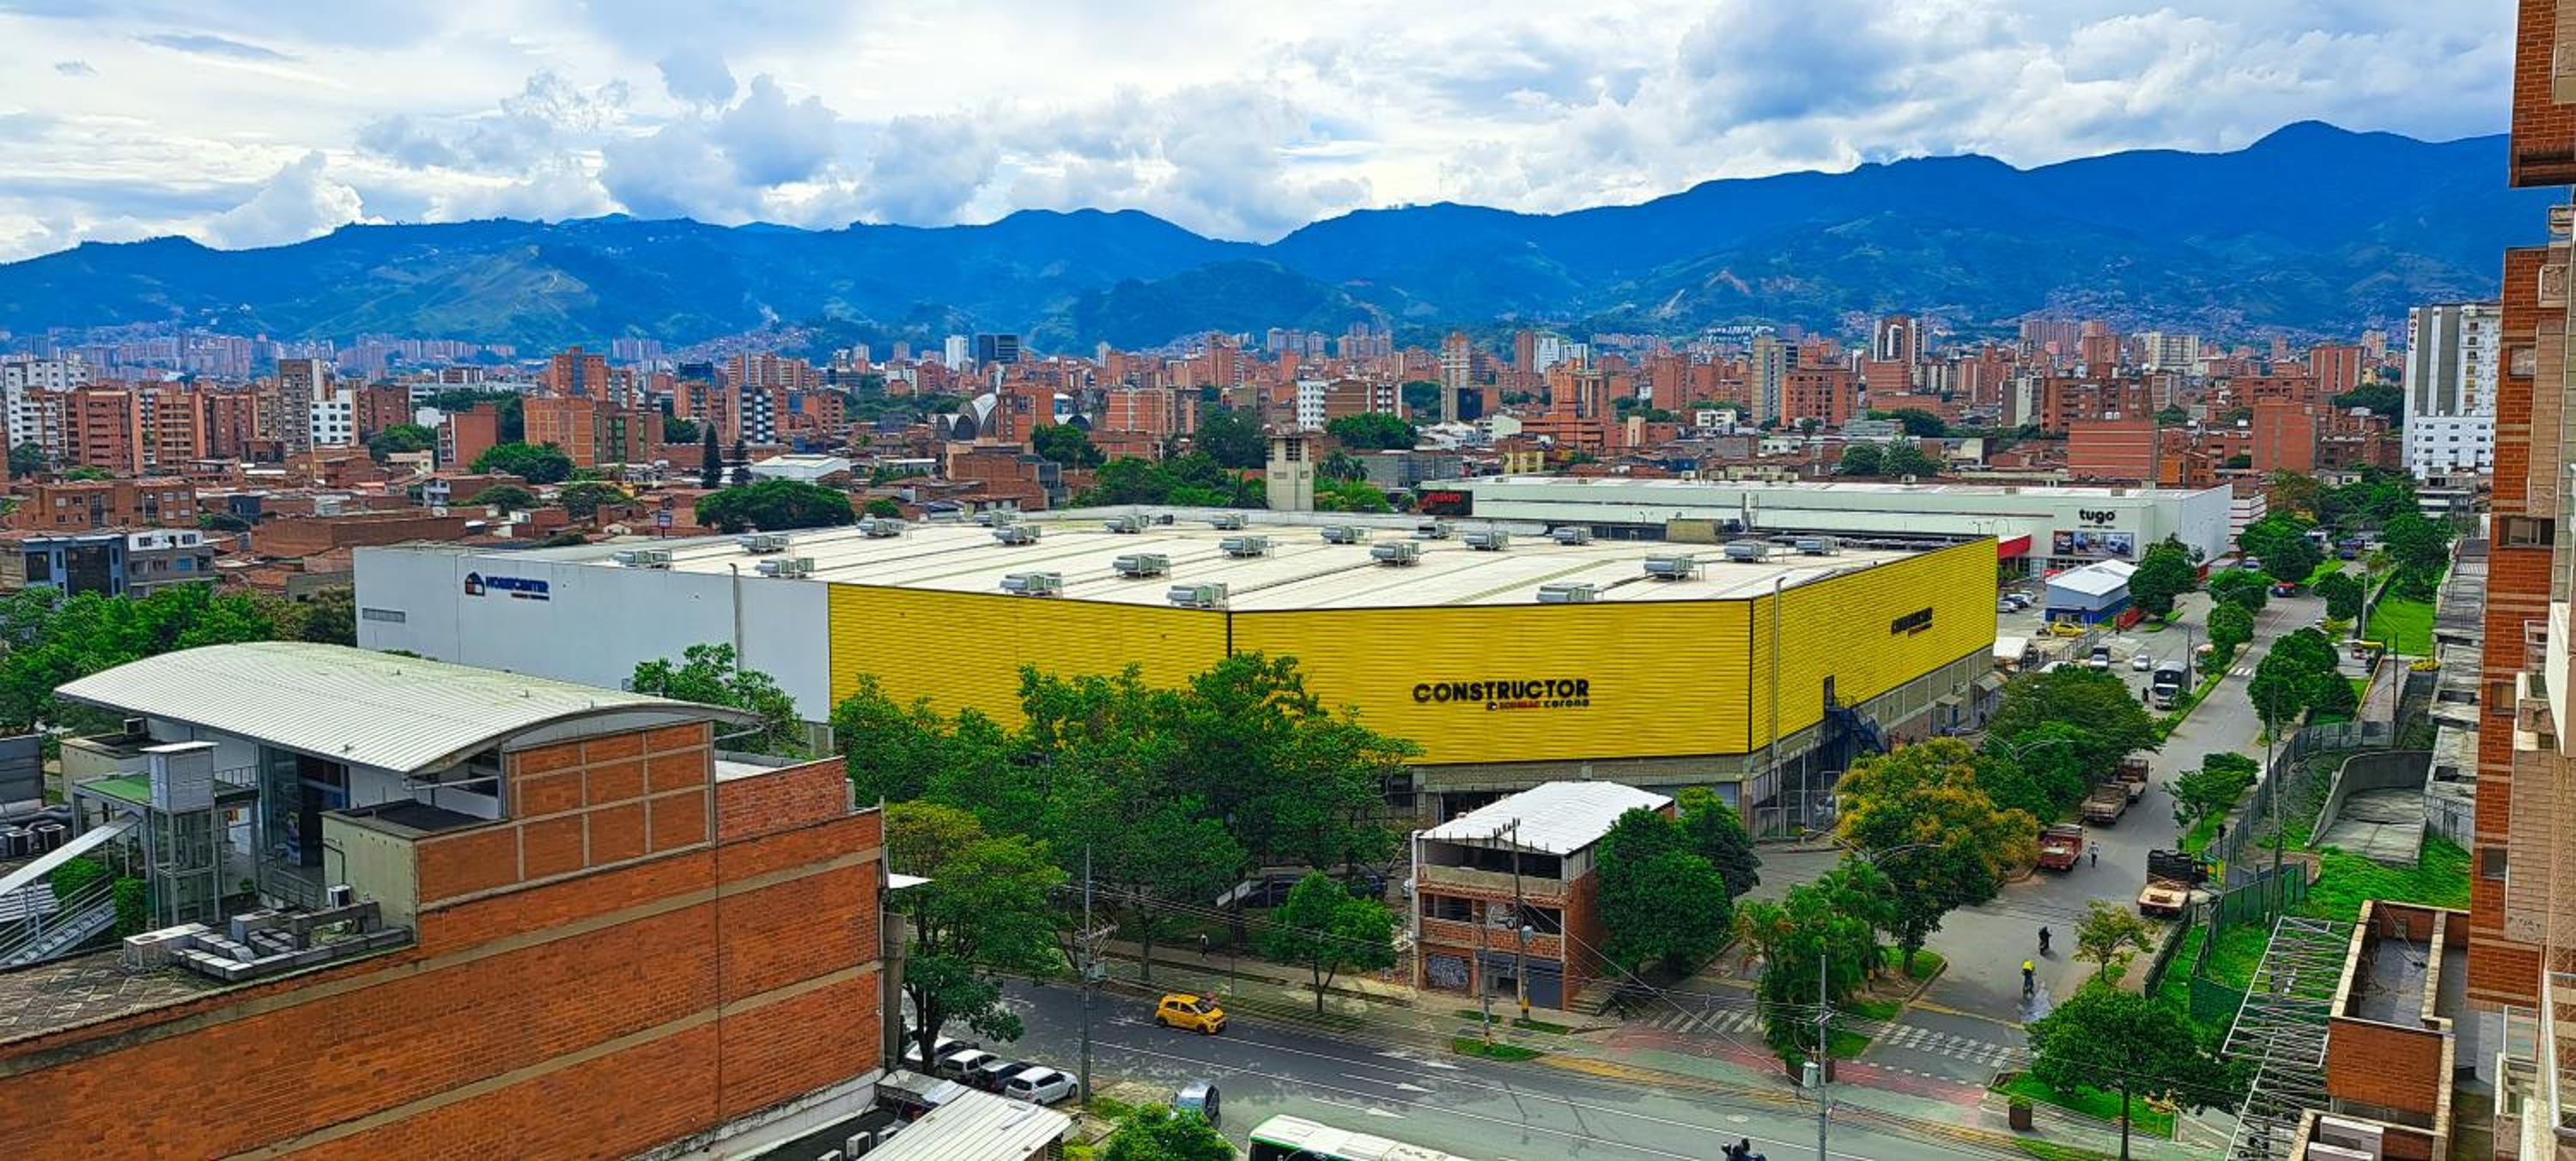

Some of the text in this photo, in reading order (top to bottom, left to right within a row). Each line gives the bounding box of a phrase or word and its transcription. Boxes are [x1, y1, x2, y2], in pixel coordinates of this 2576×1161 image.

[2079, 508, 2116, 525] tugo
[1413, 678, 1590, 703] CONSTRUCTOR
[1544, 699, 1590, 708] corona
